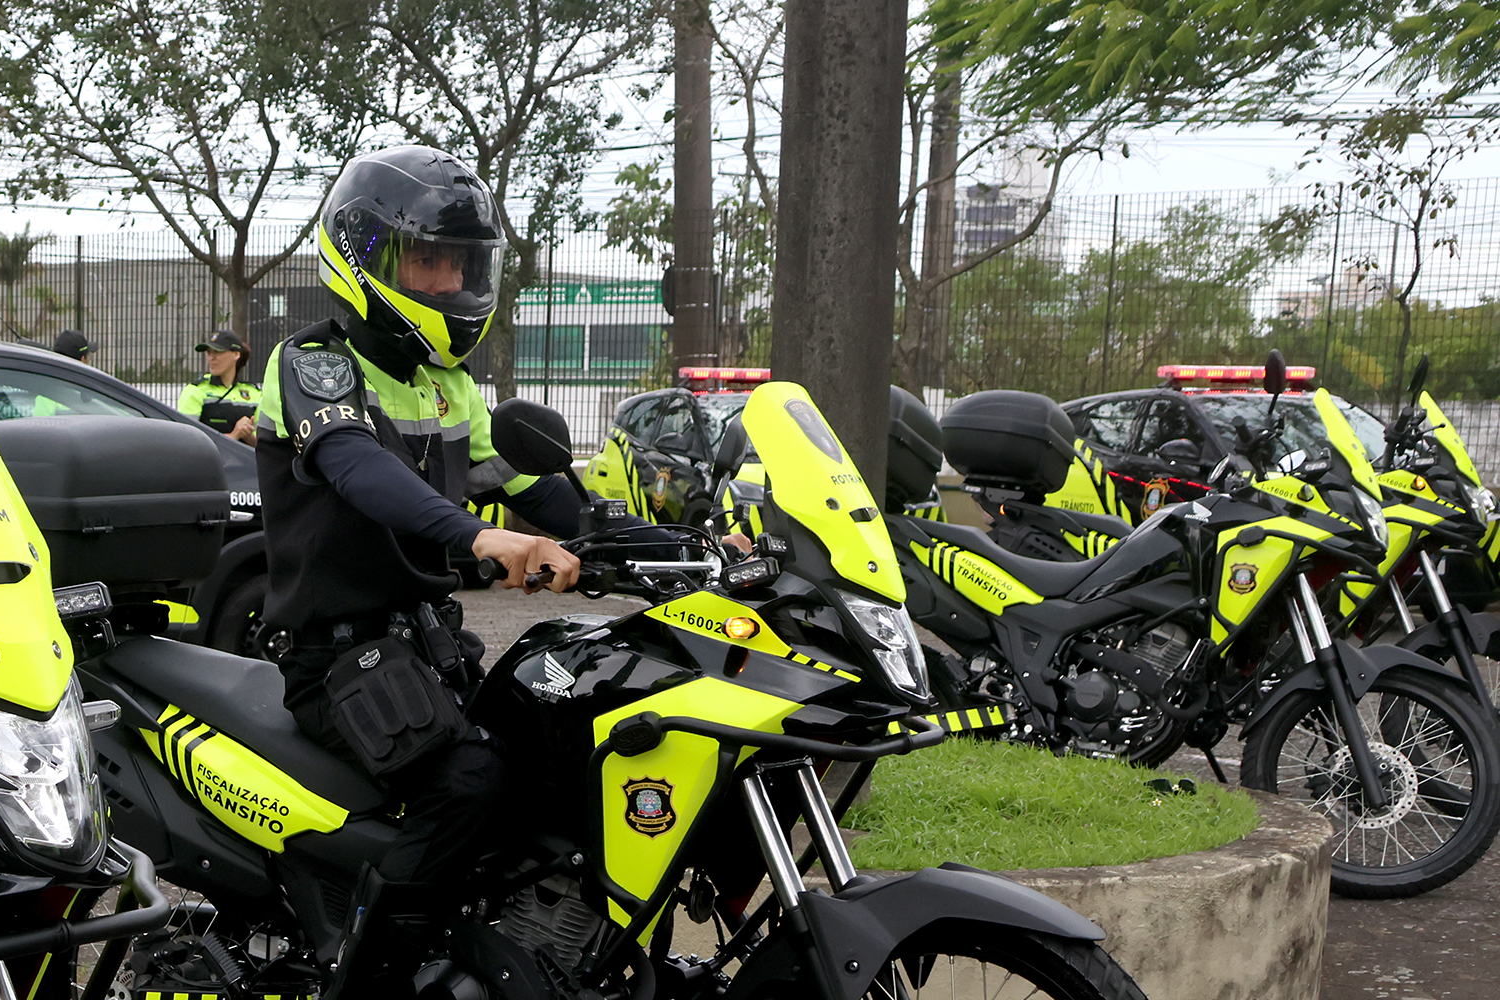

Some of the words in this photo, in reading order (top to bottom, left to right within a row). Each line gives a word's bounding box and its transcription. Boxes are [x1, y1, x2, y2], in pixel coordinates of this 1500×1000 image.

[339, 231, 365, 285] ROTRAM
[1261, 483, 1295, 500] L-16001
[1378, 476, 1408, 490] L-16004
[957, 564, 1007, 601] TRÂNSITO
[961, 557, 1013, 591] FISCALIZAÇÃO
[663, 605, 722, 634] L-16002
[531, 681, 572, 699] HONDA
[196, 776, 284, 834] TRÂNSITO
[197, 763, 290, 817] FISCALIZAÇÃO
